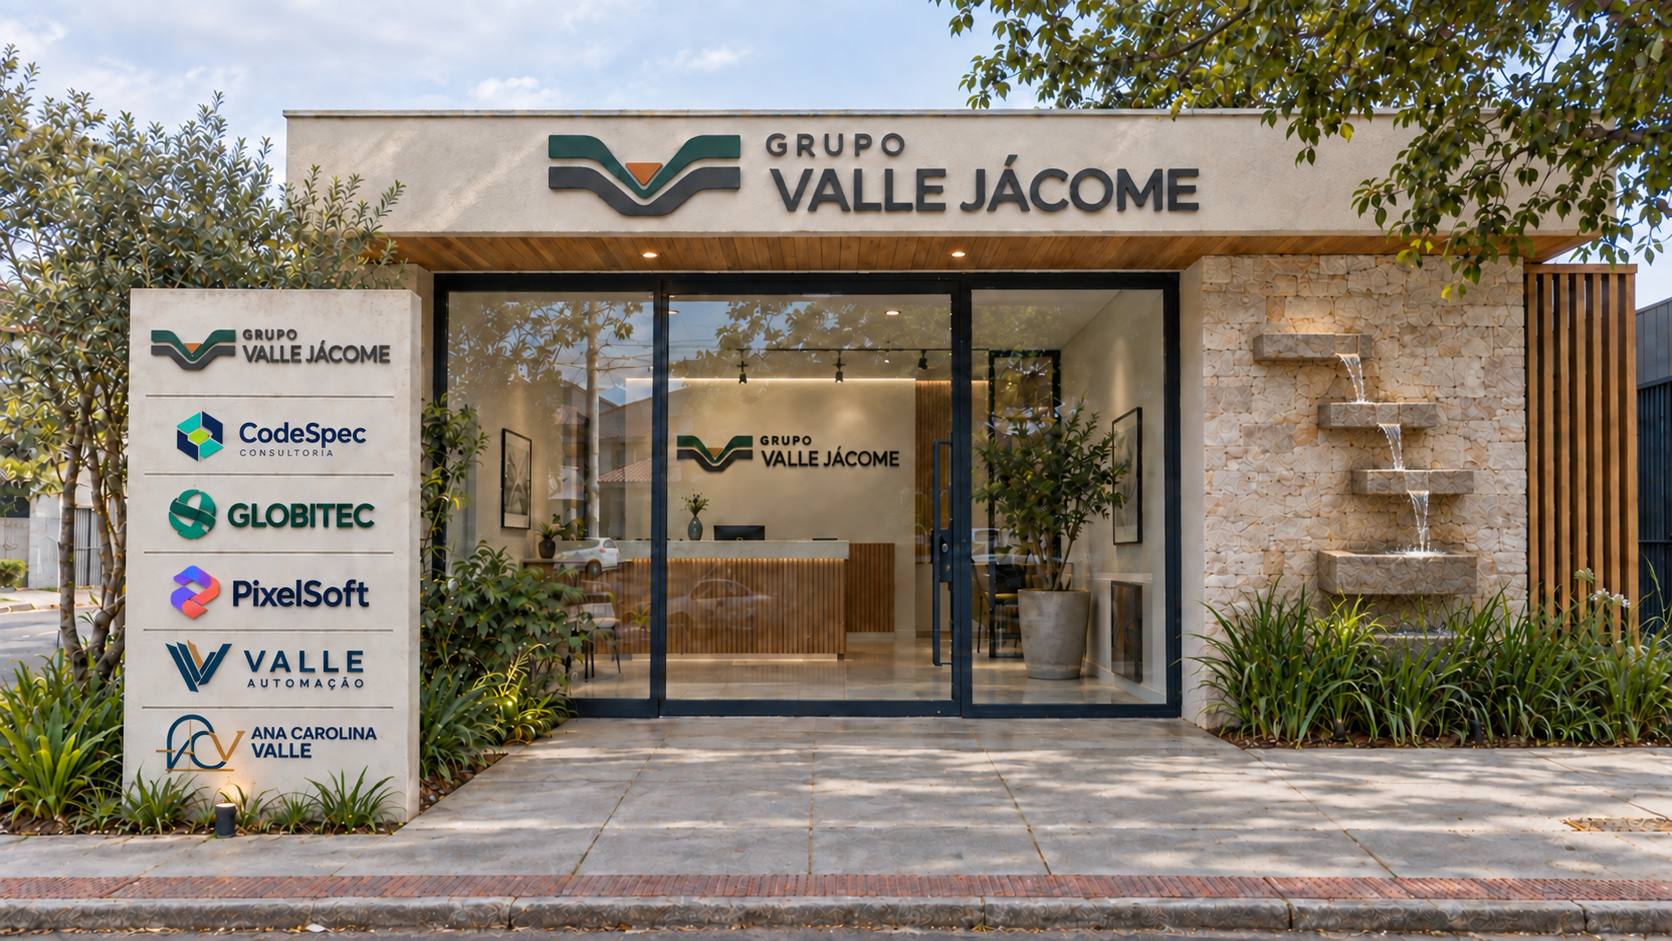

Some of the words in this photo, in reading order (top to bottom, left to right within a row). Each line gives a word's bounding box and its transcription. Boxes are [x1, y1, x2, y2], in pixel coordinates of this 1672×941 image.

[765, 132, 906, 157] GRUPO
[769, 167, 947, 213] VALLE
[959, 154, 1200, 213] JÁCOME
[242, 328, 298, 341] GRUPO
[242, 344, 302, 364] VALLE
[305, 340, 391, 364] JÁCOME
[239, 421, 367, 448] CodeSpec
[760, 435, 812, 446] GRUPO
[239, 449, 334, 457] CONSULTORIA
[761, 450, 819, 467] VALLE
[823, 446, 900, 467] JÁCOME
[227, 502, 376, 528] GLOBITEC
[232, 579, 370, 607] PixelSoft
[243, 650, 364, 673] VALLE
[247, 676, 364, 690] AUTOMAÇÃO
[251, 726, 288, 740] ANA
[290, 726, 377, 740] CAROLINA
[251, 743, 312, 759] VALLE
